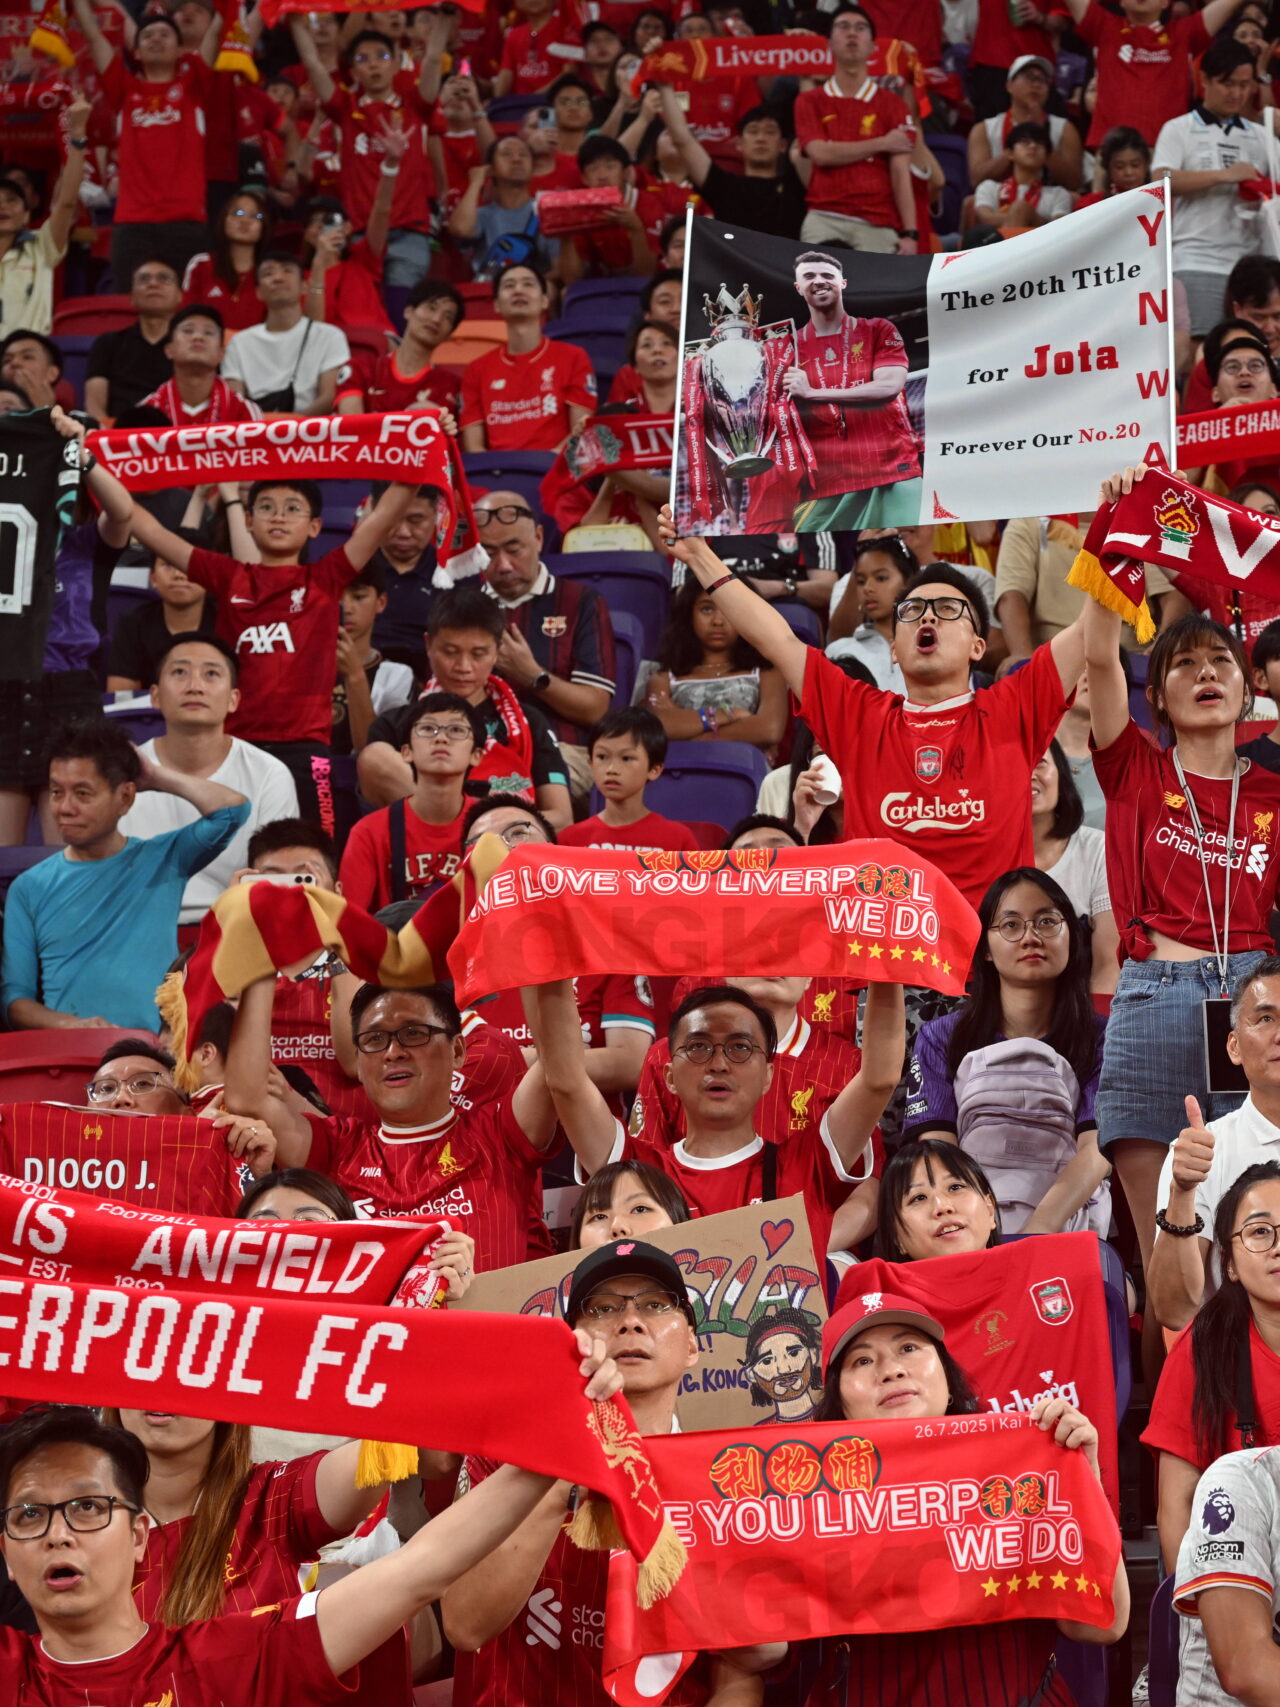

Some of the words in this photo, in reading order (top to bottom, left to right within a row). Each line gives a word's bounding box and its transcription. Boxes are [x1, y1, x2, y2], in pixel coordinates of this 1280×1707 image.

[716, 45, 832, 69] Liverpool
[941, 290, 994, 311] The
[1002, 276, 1065, 304] 20th
[1072, 261, 1141, 290] Title
[967, 367, 1009, 384] for
[1024, 341, 1119, 379] Jota
[99, 416, 359, 461] LIVERPOOL
[379, 414, 440, 447] FC
[778, 405, 789, 437] League
[1176, 416, 1231, 446] EAGUE
[788, 437, 797, 471] Premier
[940, 438, 1027, 456] Forever
[1032, 432, 1073, 449] Our
[1078, 422, 1141, 444] No.20
[108, 452, 190, 479] YOU'LL
[195, 446, 269, 469] NEVER
[276, 445, 349, 464] WALK
[355, 444, 428, 467] ALONE
[235, 621, 296, 653] AXA
[880, 789, 985, 833] Carlsberg
[1156, 827, 1243, 870] Chartered
[521, 864, 619, 903] LOVE
[619, 867, 712, 897] YOU
[823, 896, 887, 936] WE
[889, 902, 941, 945] DO
[271, 1034, 334, 1048] tandar
[271, 1044, 336, 1061] hartere
[24, 1157, 126, 1190] DIOGO
[134, 1160, 156, 1190] J.
[95, 1202, 198, 1227] FOOTBALL
[12, 1197, 76, 1255] IS
[131, 1225, 387, 1295] ANFIELD
[28, 1257, 72, 1282] EST.
[296, 1314, 409, 1408] FC
[914, 1420, 988, 1440] 26.7.2025
[999, 1415, 1024, 1432] Kai
[709, 1435, 881, 1499] 利物浦
[696, 1495, 804, 1546] YOU
[946, 1525, 1023, 1572] WE
[1027, 1517, 1083, 1565] DO
[1208, 1550, 1244, 1562] racism
[1209, 1541, 1239, 1552] room
